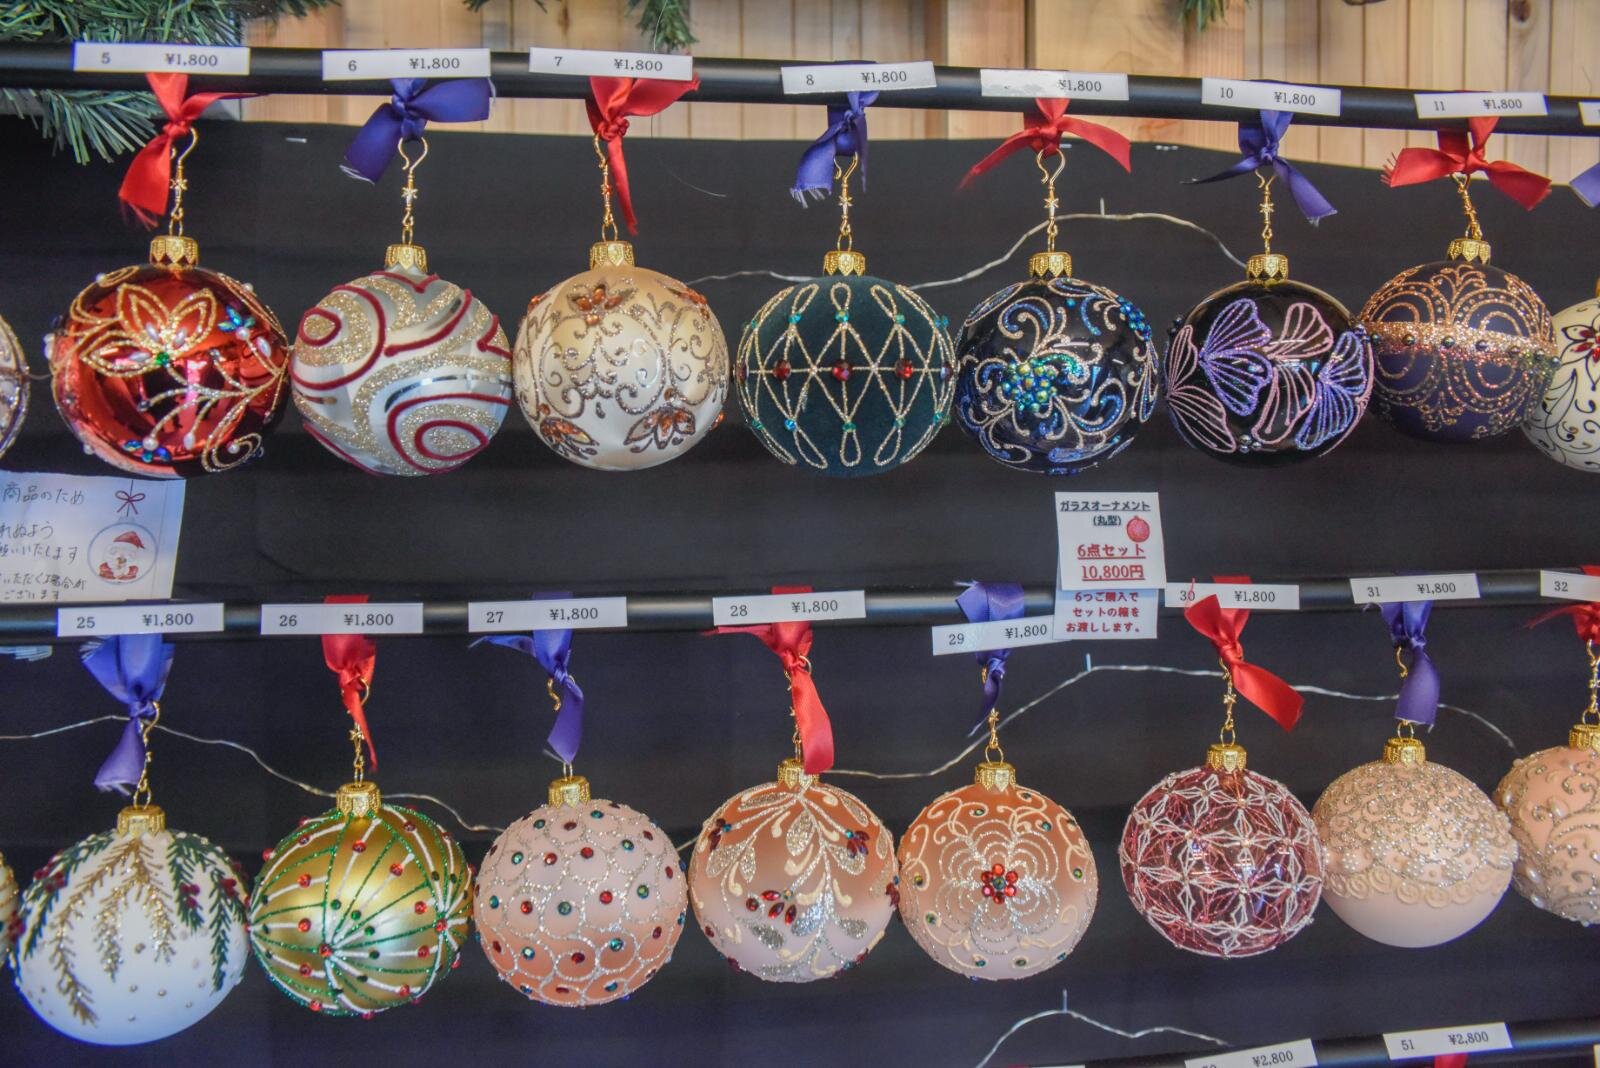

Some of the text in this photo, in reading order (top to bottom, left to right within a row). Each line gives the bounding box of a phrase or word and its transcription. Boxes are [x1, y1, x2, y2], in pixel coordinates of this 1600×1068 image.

[101, 52, 218, 68] 5 ¥1,800
[348, 57, 461, 72] 6 ¥1,800
[554, 56, 663, 72] 7 ¥1,800
[806, 71, 907, 86] 8 ¥1,800
[1220, 87, 1316, 106] 10 ¥1,800
[1434, 99, 1522, 112] 11 ¥1,800
[1060, 501, 1151, 512] ガラスオーナメント
[1092, 514, 1122, 526] (丸型)
[1077, 543, 1145, 557] 6点セット
[1081, 565, 1144, 579] 10,800円
[1367, 582, 1456, 597] 31 ¥1,800
[1554, 581, 1568, 592] 32
[1180, 590, 1276, 603] 30 ¥1,800
[486, 606, 599, 623] 27 ¥1,800
[730, 599, 839, 617] 28 ¥1,800
[76, 613, 194, 629] 25 ¥1,800
[279, 613, 394, 627] 26 ¥1,800
[948, 624, 1047, 645] 29 ¥1,800
[1401, 1031, 1489, 1051] 51 ¥2,800
[1252, 1050, 1294, 1067] ¥2,800
